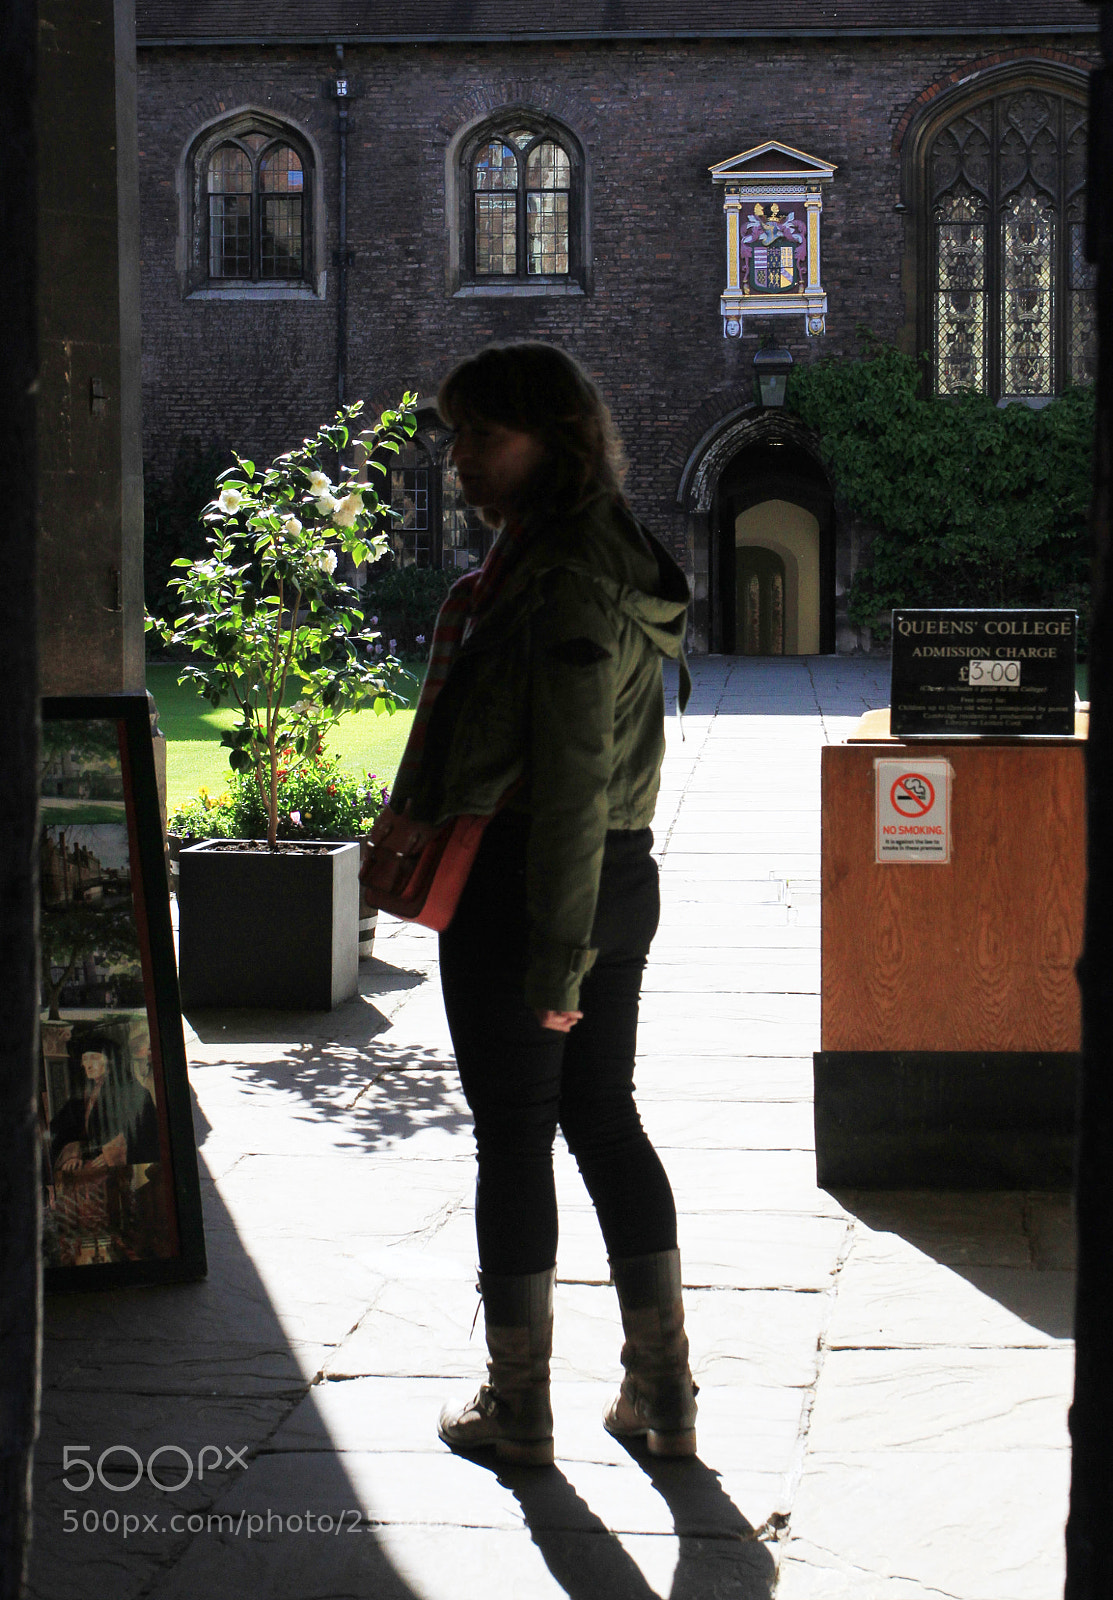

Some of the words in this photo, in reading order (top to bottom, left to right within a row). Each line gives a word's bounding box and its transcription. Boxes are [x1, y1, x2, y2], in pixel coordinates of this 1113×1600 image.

[899, 620, 978, 636] QUEENS'
[984, 621, 1072, 635] COLLEGE
[912, 647, 991, 658] ADMISSION
[996, 647, 1057, 658] CHARGE
[883, 826, 897, 834] NO
